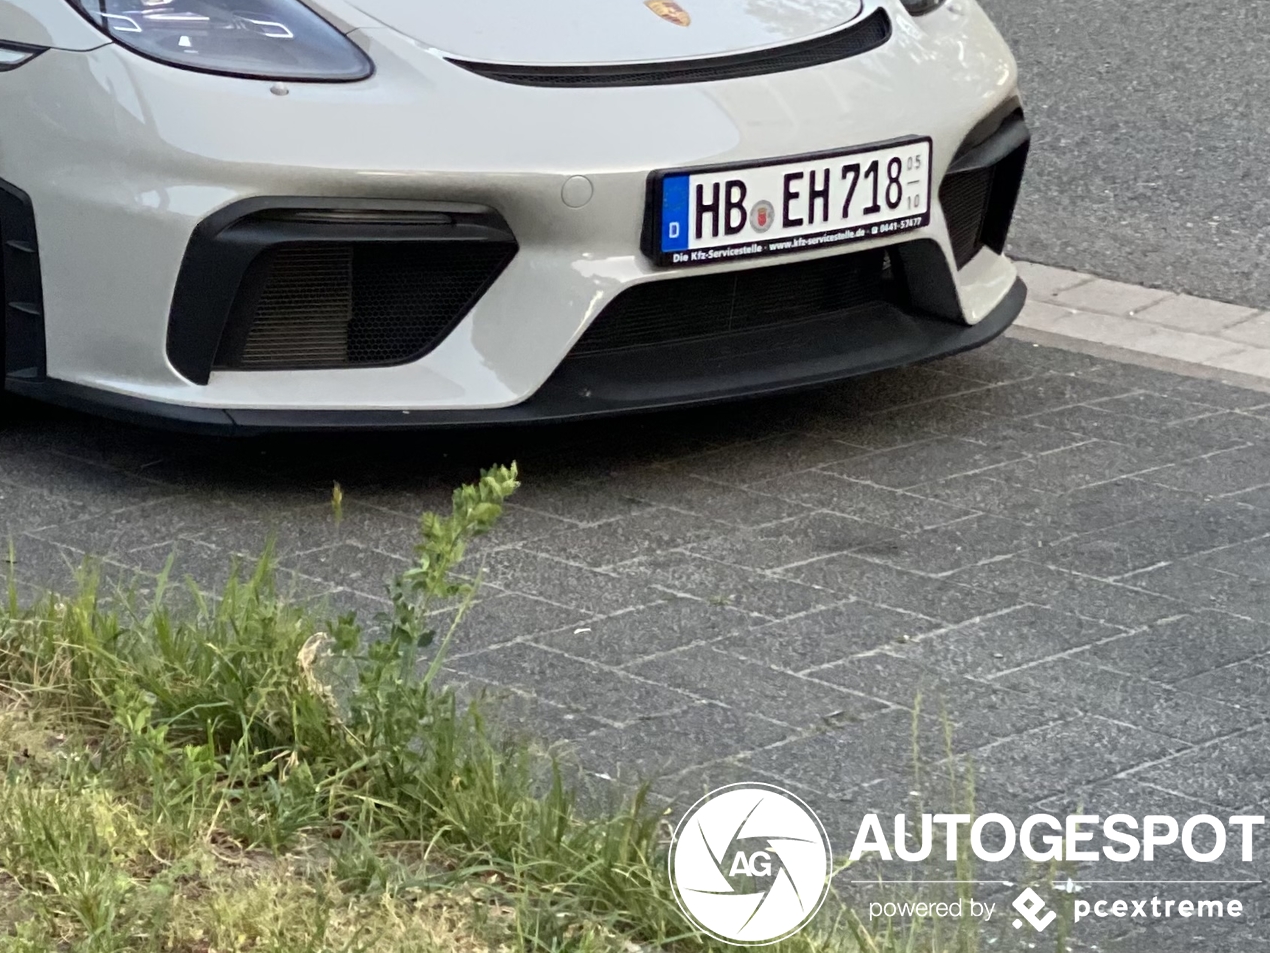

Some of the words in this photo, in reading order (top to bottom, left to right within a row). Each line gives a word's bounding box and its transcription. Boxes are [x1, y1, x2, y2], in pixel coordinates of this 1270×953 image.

[907, 154, 921, 171] 05
[695, 179, 747, 239] HB
[782, 168, 830, 228] EH
[841, 156, 903, 218] 718
[907, 194, 920, 210] 10
[669, 222, 679, 238] D
[673, 253, 689, 263] Die
[691, 243, 763, 260] Kfz-Servicestelle
[769, 228, 865, 251] www.kfz-servicestelle.de
